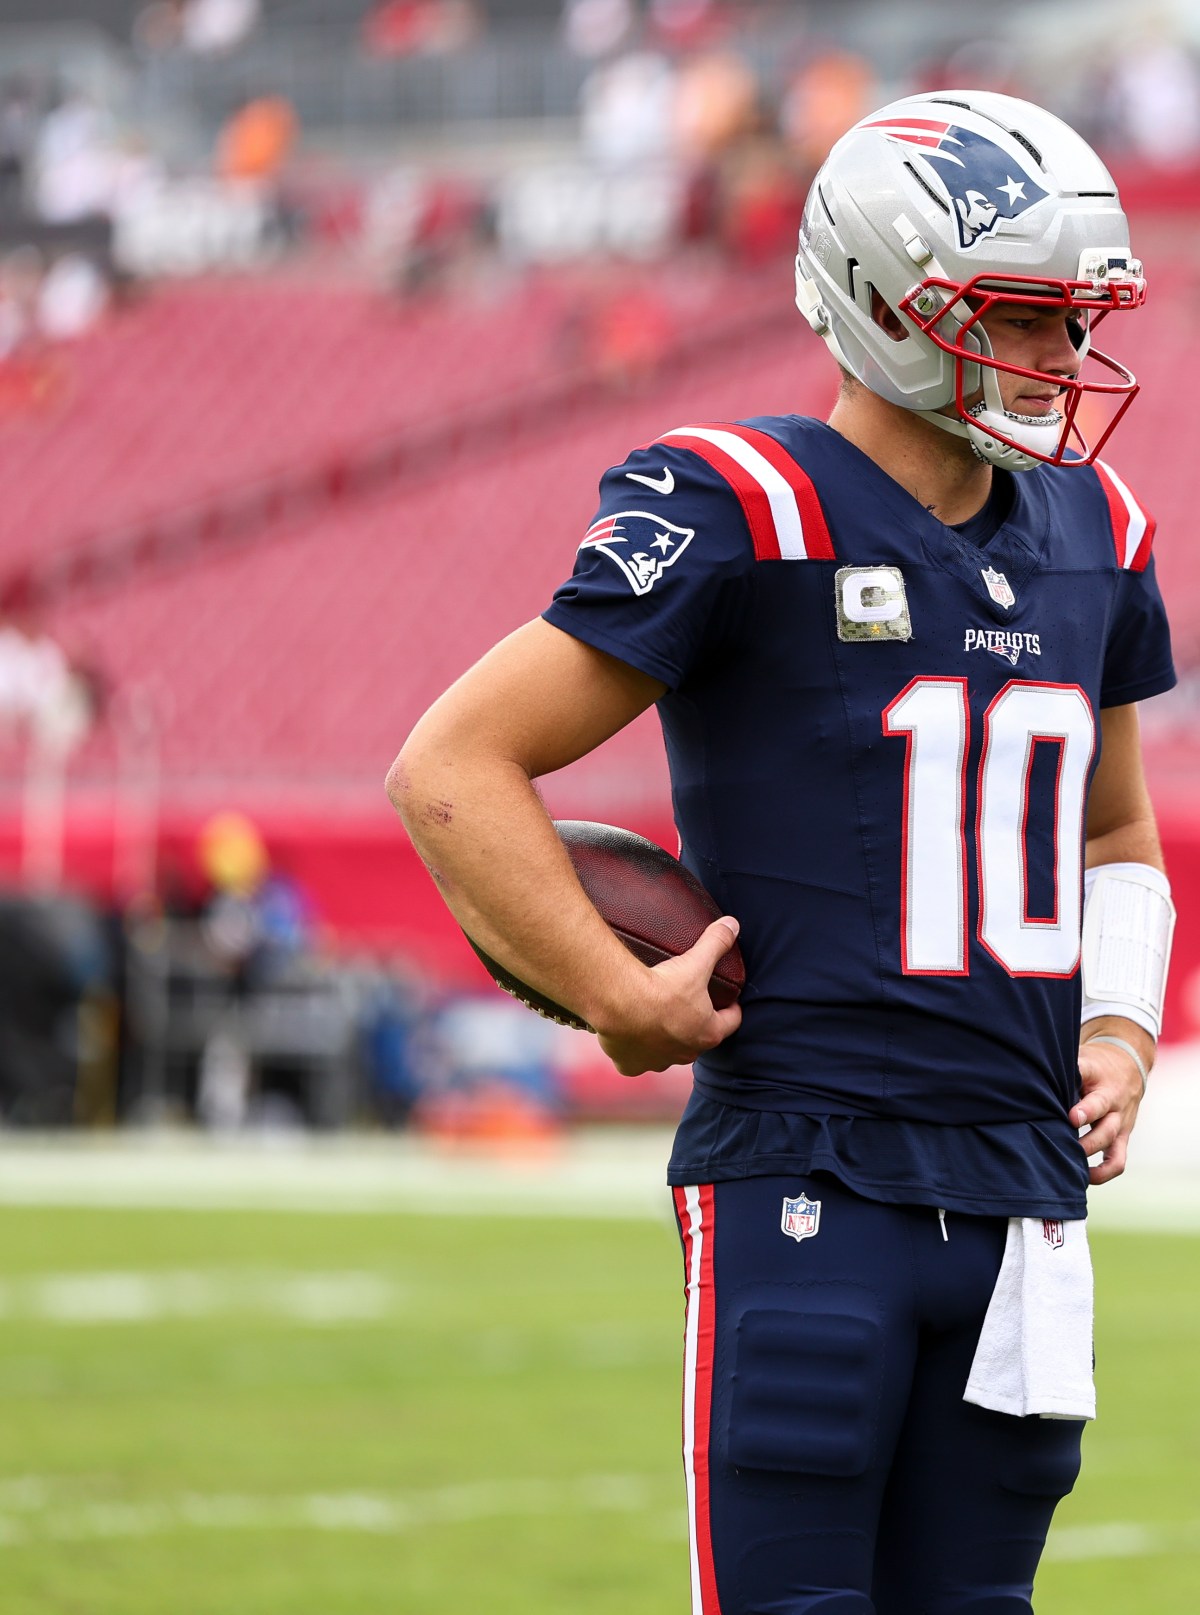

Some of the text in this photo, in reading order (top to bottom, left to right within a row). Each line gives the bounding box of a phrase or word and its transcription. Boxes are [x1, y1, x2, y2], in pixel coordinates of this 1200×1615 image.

[842, 572, 903, 622] C
[992, 585, 1012, 600] NFL
[964, 629, 1042, 656] PATRIOTS
[882, 675, 1095, 979] 10
[787, 1214, 813, 1233] NFL
[1042, 1219, 1062, 1245] NFL
